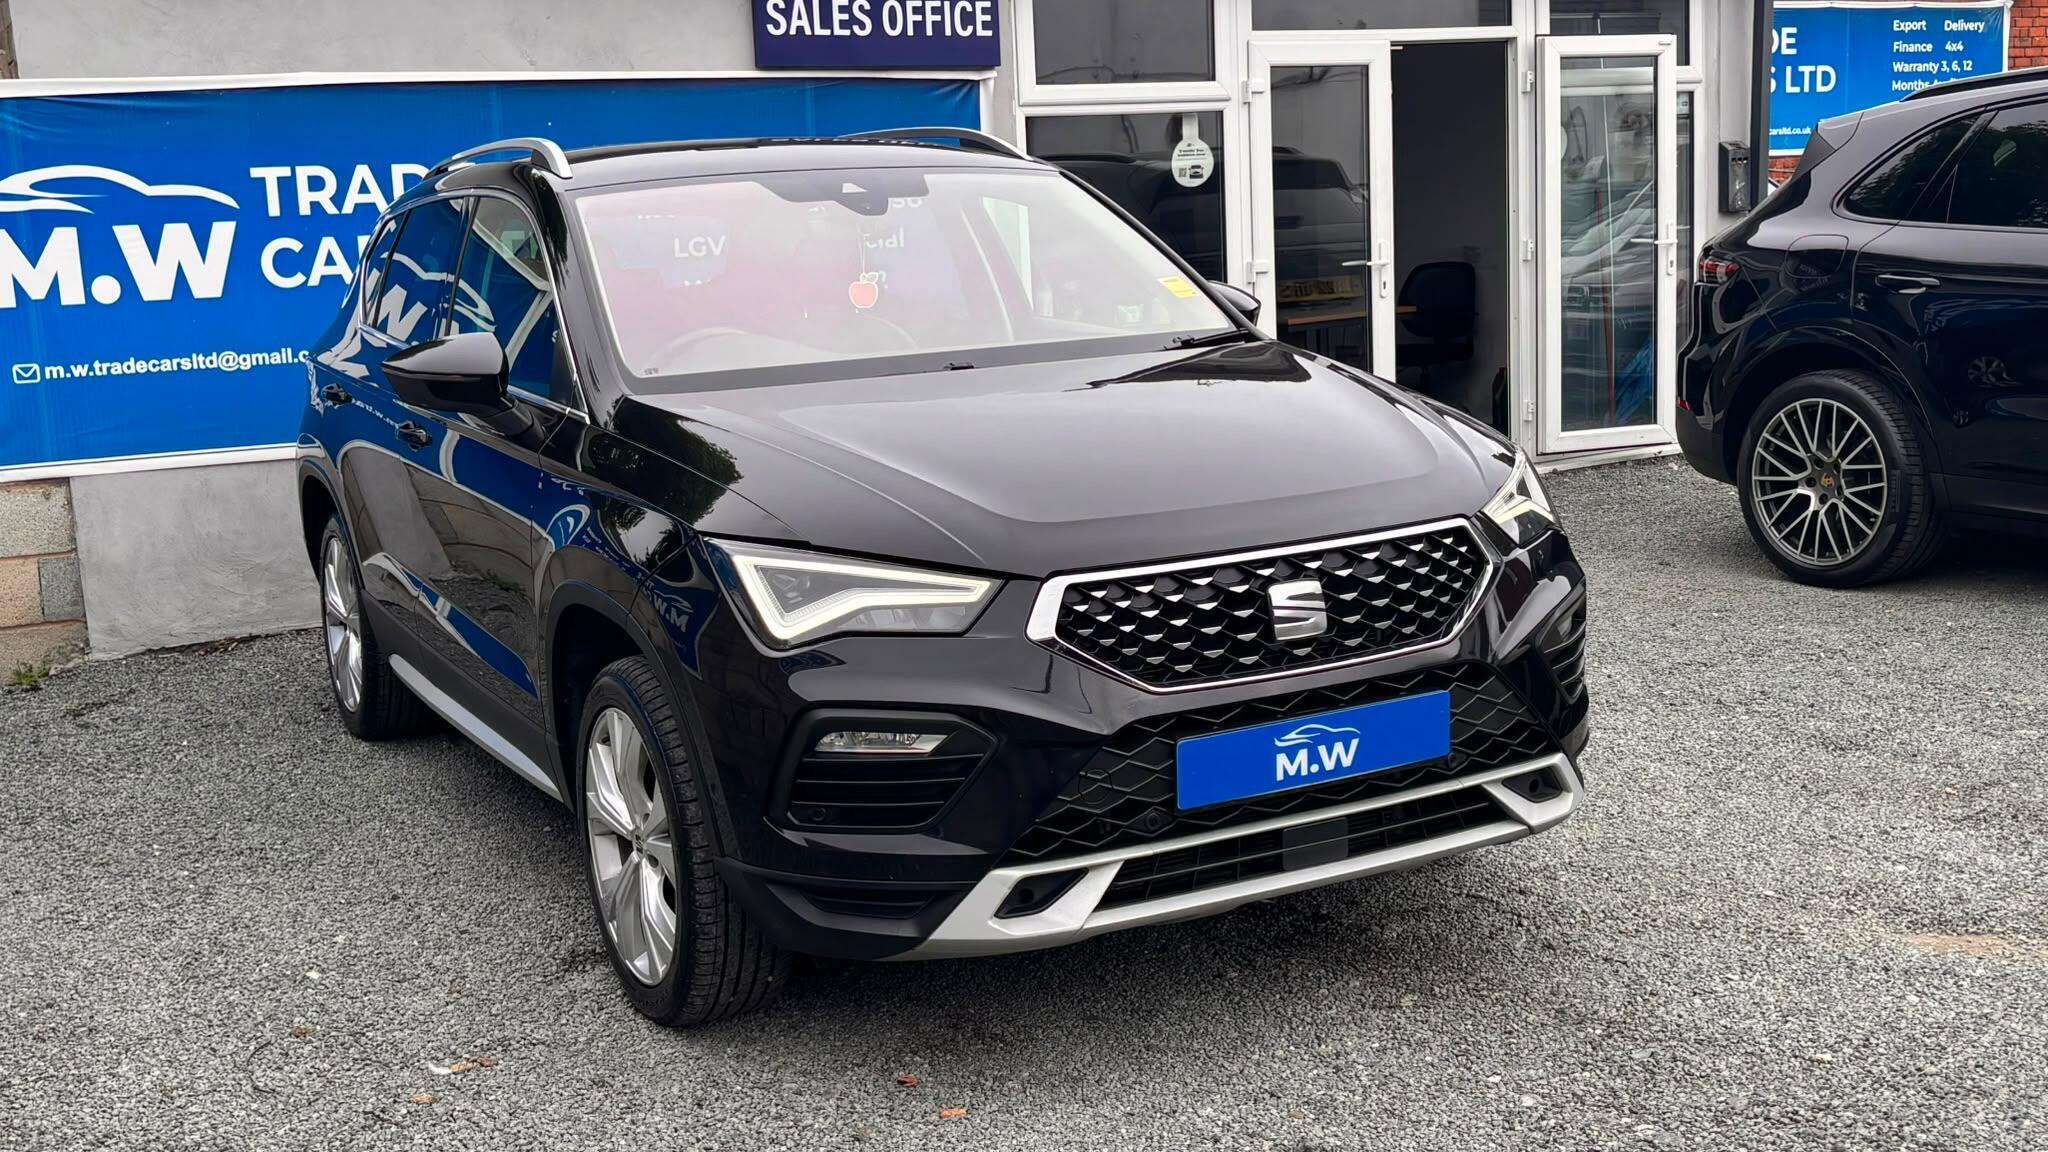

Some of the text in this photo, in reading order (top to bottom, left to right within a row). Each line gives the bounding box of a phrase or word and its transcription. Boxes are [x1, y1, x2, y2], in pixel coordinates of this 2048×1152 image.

[766, 0, 993, 37] SALES OFFICE
[1893, 19, 1985, 33] Export Delivery
[1893, 41, 1964, 52] Finance 4x4
[1785, 64, 1837, 93] LTD
[1893, 60, 1973, 74] Warranty 3, 6, 12
[674, 235, 726, 258] LGV
[0, 220, 237, 309] M.W
[1275, 738, 1360, 782] M.W
